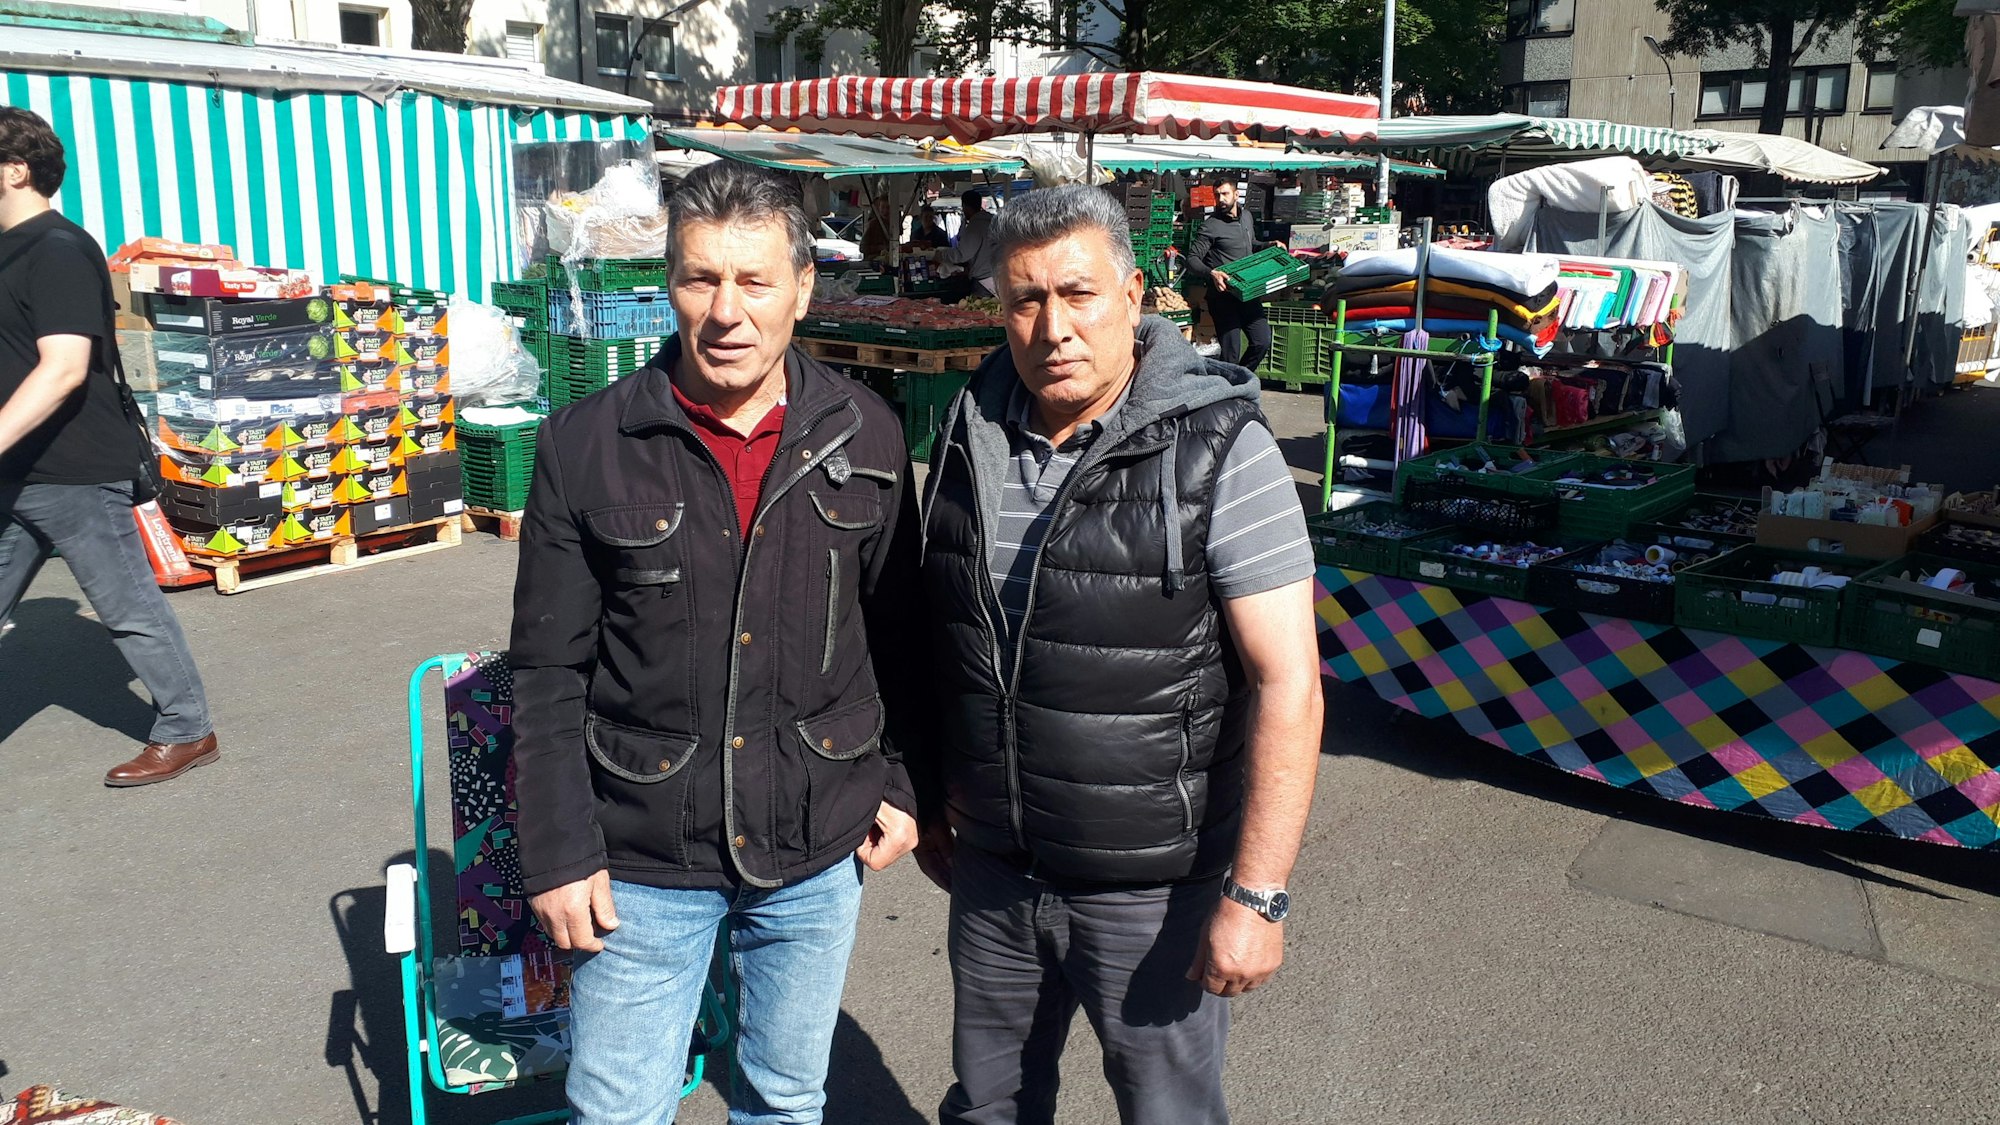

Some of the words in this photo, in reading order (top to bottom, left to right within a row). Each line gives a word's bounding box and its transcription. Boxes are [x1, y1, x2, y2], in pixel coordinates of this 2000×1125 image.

[224, 282, 240, 290] Tasty
[232, 315, 254, 325] Royal
[234, 350, 256, 362] Royal
[257, 349, 278, 358] Verde
